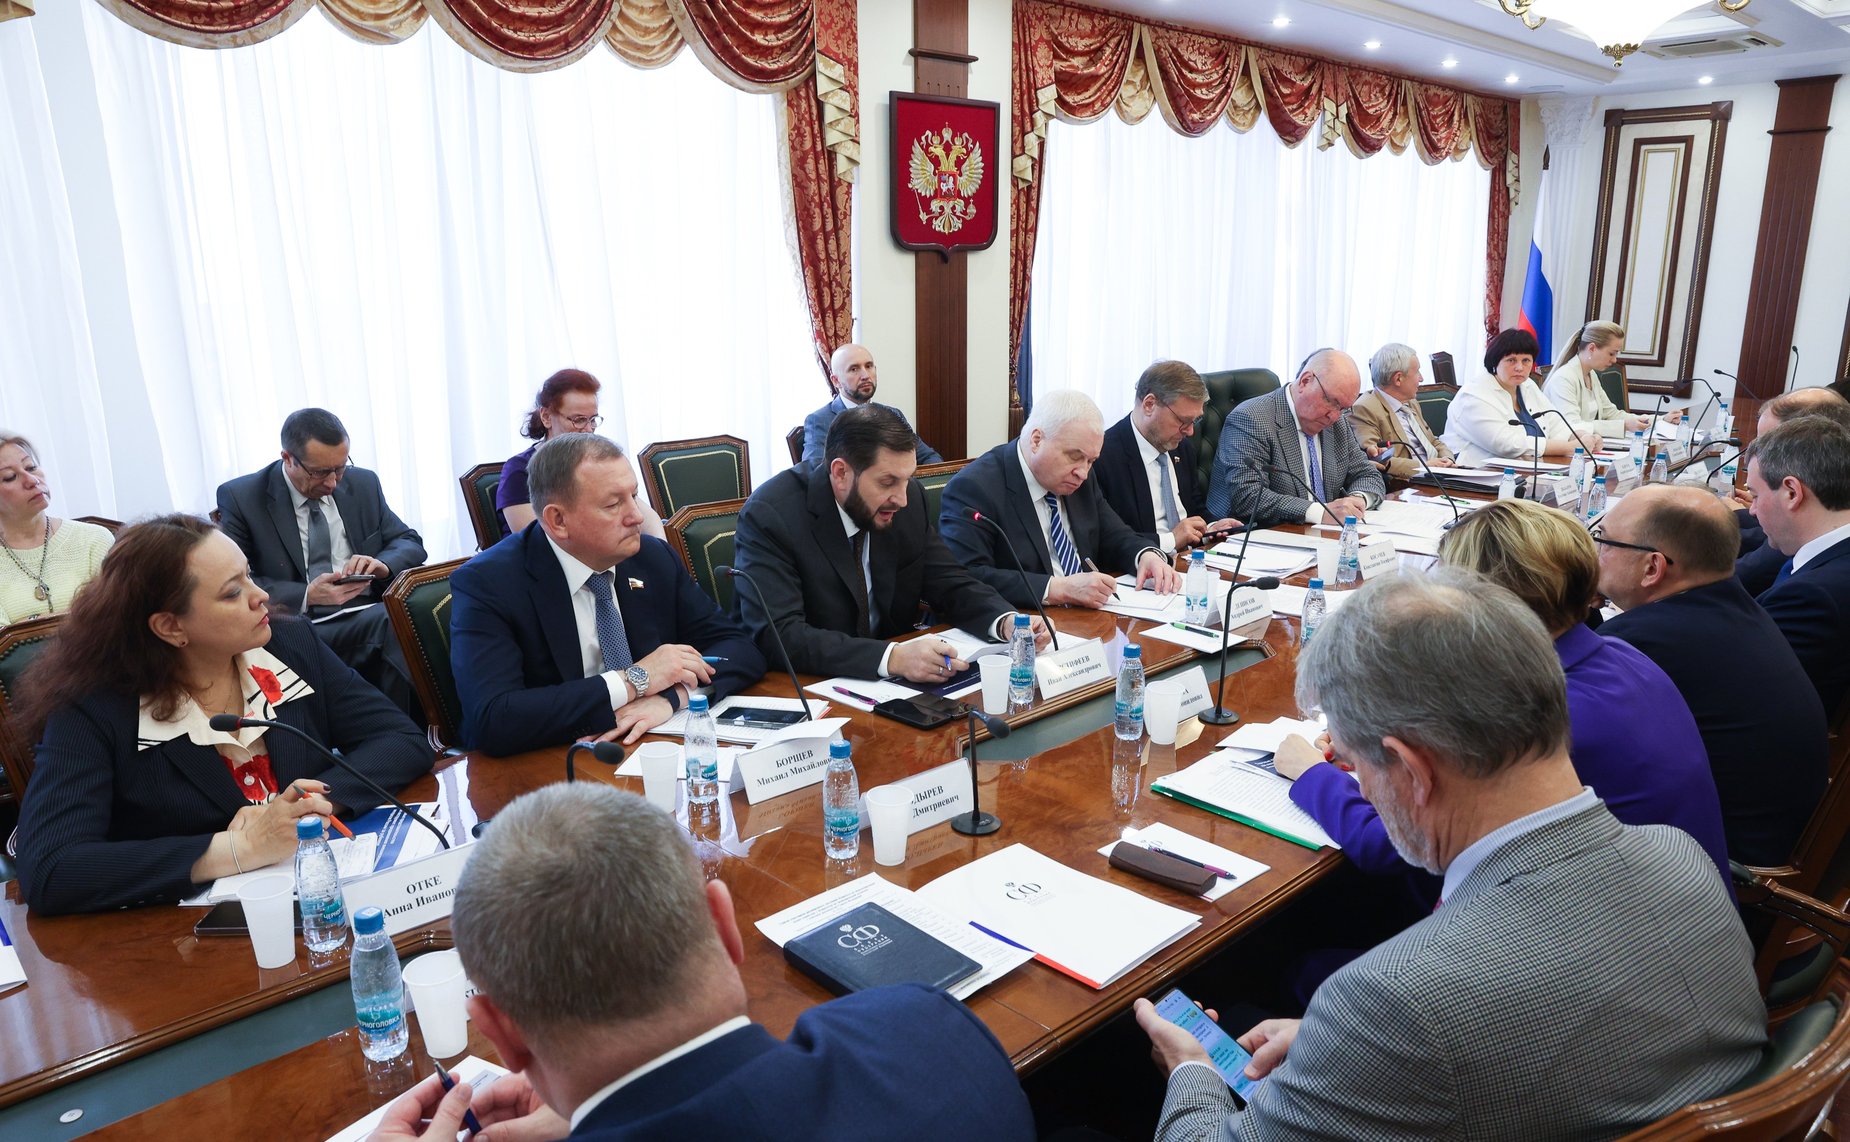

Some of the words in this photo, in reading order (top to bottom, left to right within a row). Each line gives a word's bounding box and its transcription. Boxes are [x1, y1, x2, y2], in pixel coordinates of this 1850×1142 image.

[775, 749, 814, 769] БОРЩЕВ
[756, 771, 789, 788] Михаил
[911, 785, 944, 805] ДЫРЕВ
[912, 794, 960, 818] Дмитриевич
[406, 875, 442, 895] ОТКЕ
[383, 902, 414, 918] Анна
[837, 924, 880, 948] СФ
